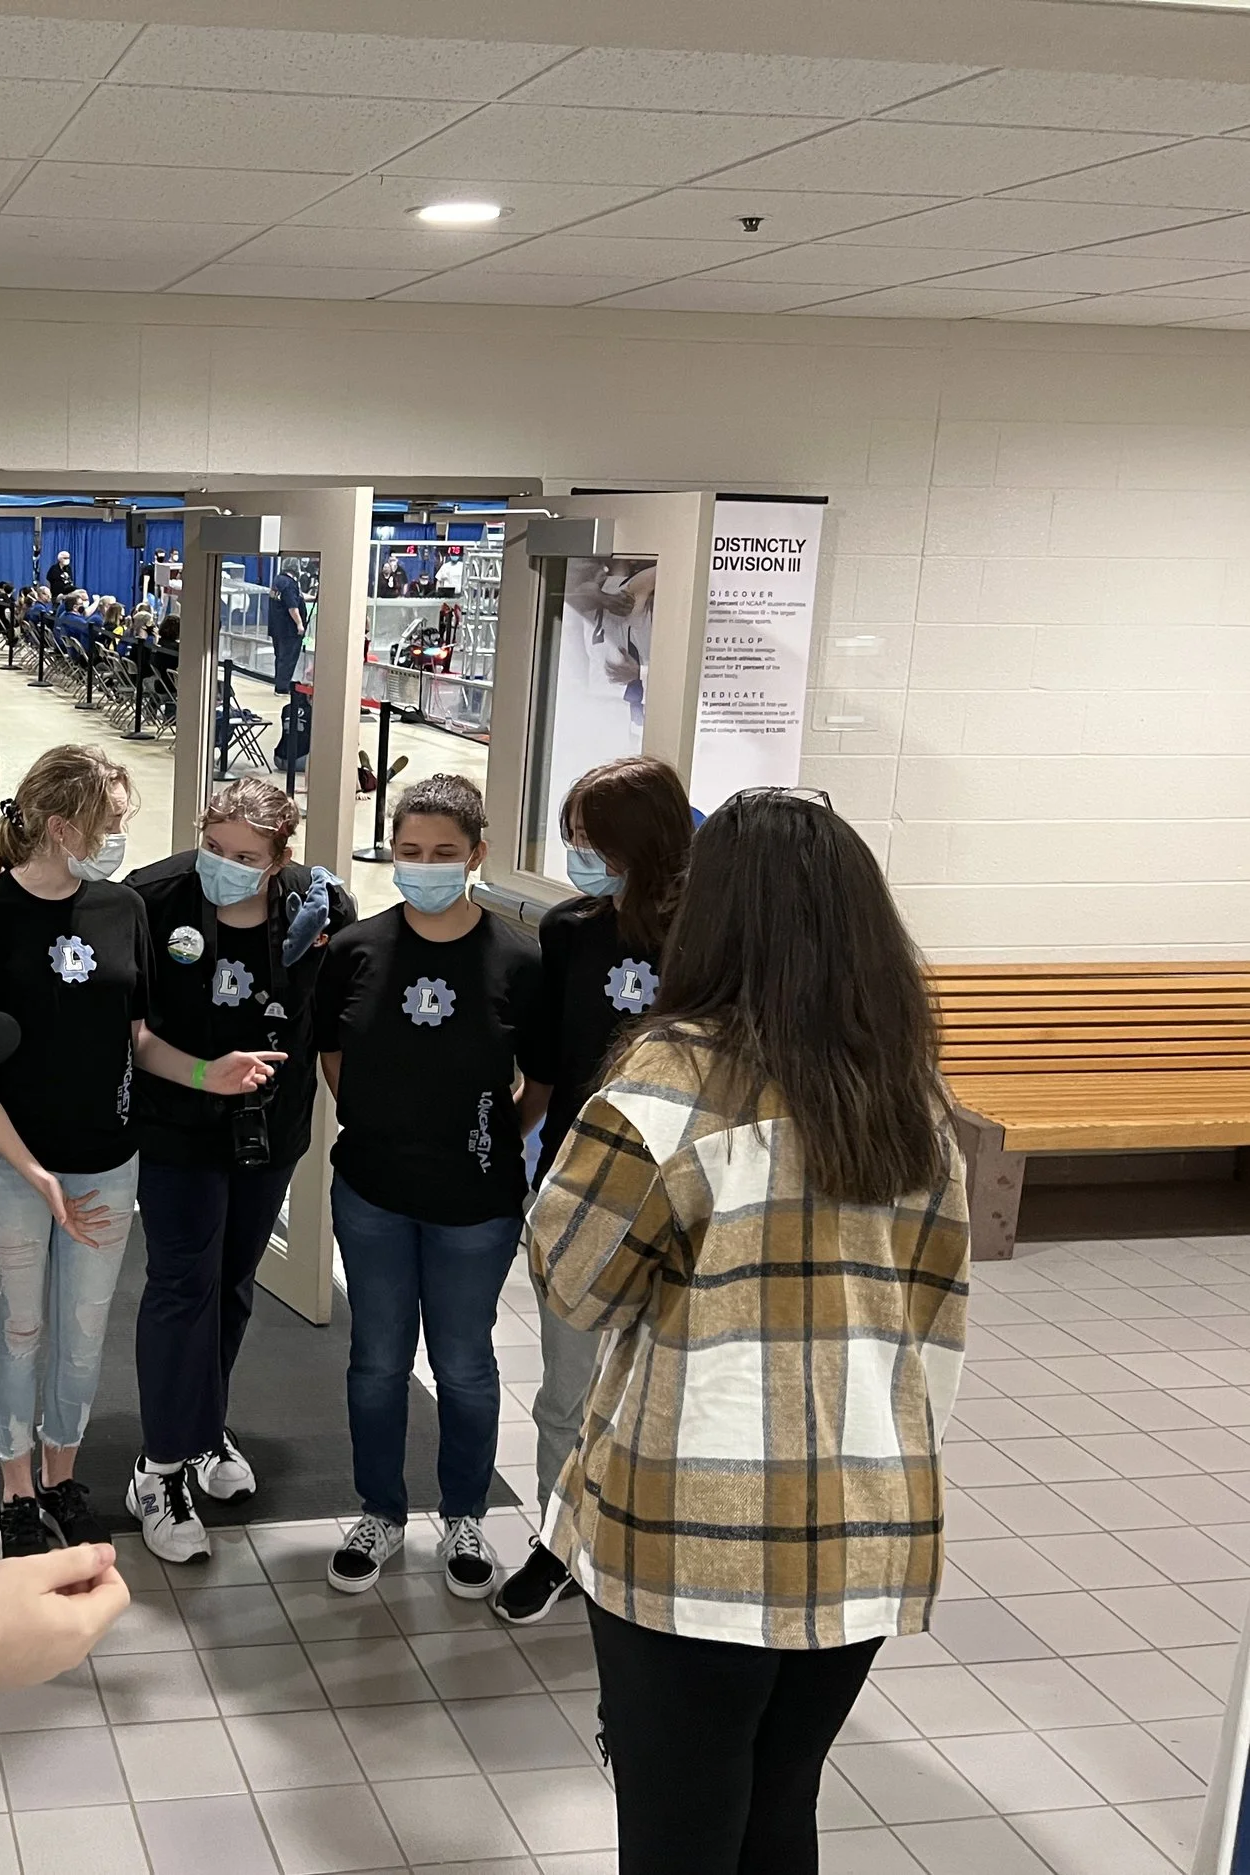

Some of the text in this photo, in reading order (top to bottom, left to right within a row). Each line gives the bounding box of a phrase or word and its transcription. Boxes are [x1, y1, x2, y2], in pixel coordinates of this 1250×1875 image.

[714, 537, 806, 553] DISTINCTLY
[712, 556, 801, 572] DIVISION III
[709, 590, 774, 598] DISCOVER
[62, 946, 83, 971] L
[218, 969, 239, 996] L
[620, 969, 642, 1000] L
[418, 987, 440, 1014] L
